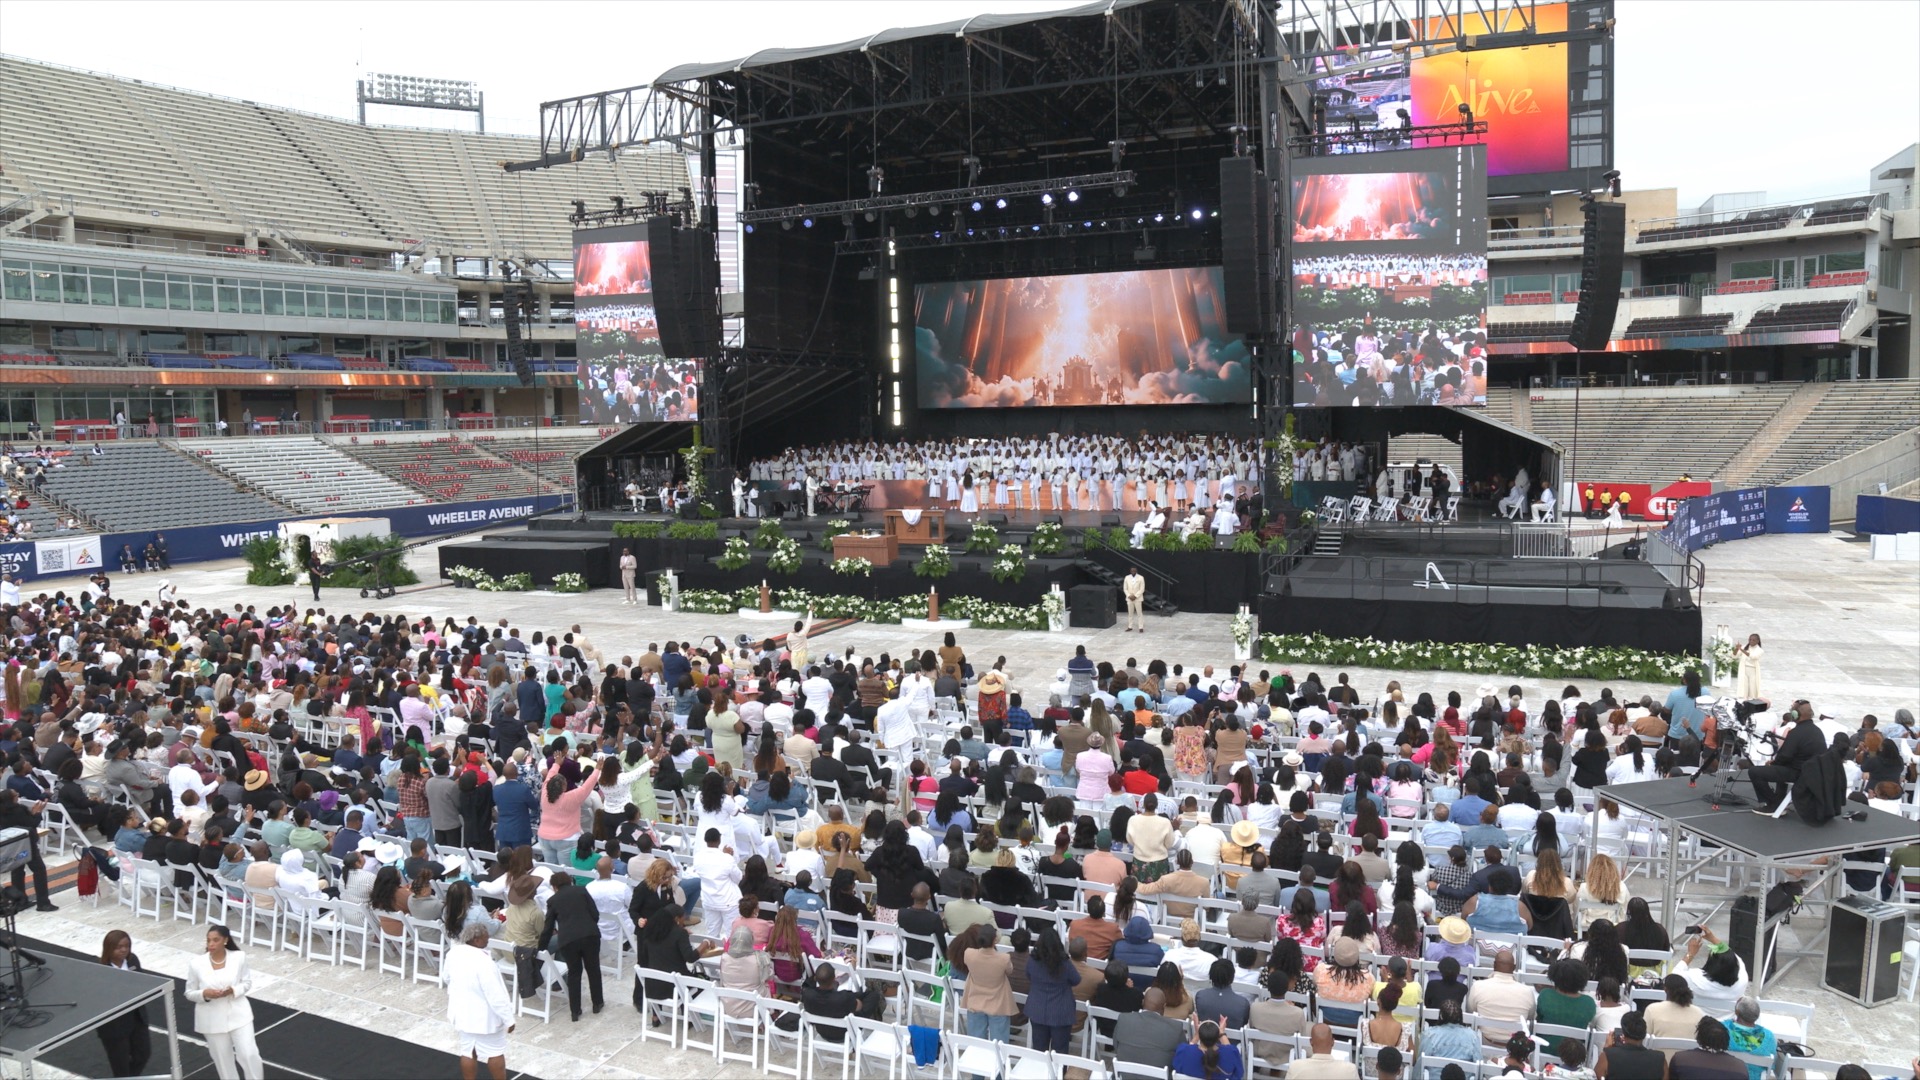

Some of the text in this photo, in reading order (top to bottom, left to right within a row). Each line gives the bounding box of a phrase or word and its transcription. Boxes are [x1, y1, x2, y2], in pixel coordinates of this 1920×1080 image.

[1436, 79, 1533, 120] Alive
[428, 505, 534, 526] WHEELER AVENUE
[0, 551, 31, 564] STAY
